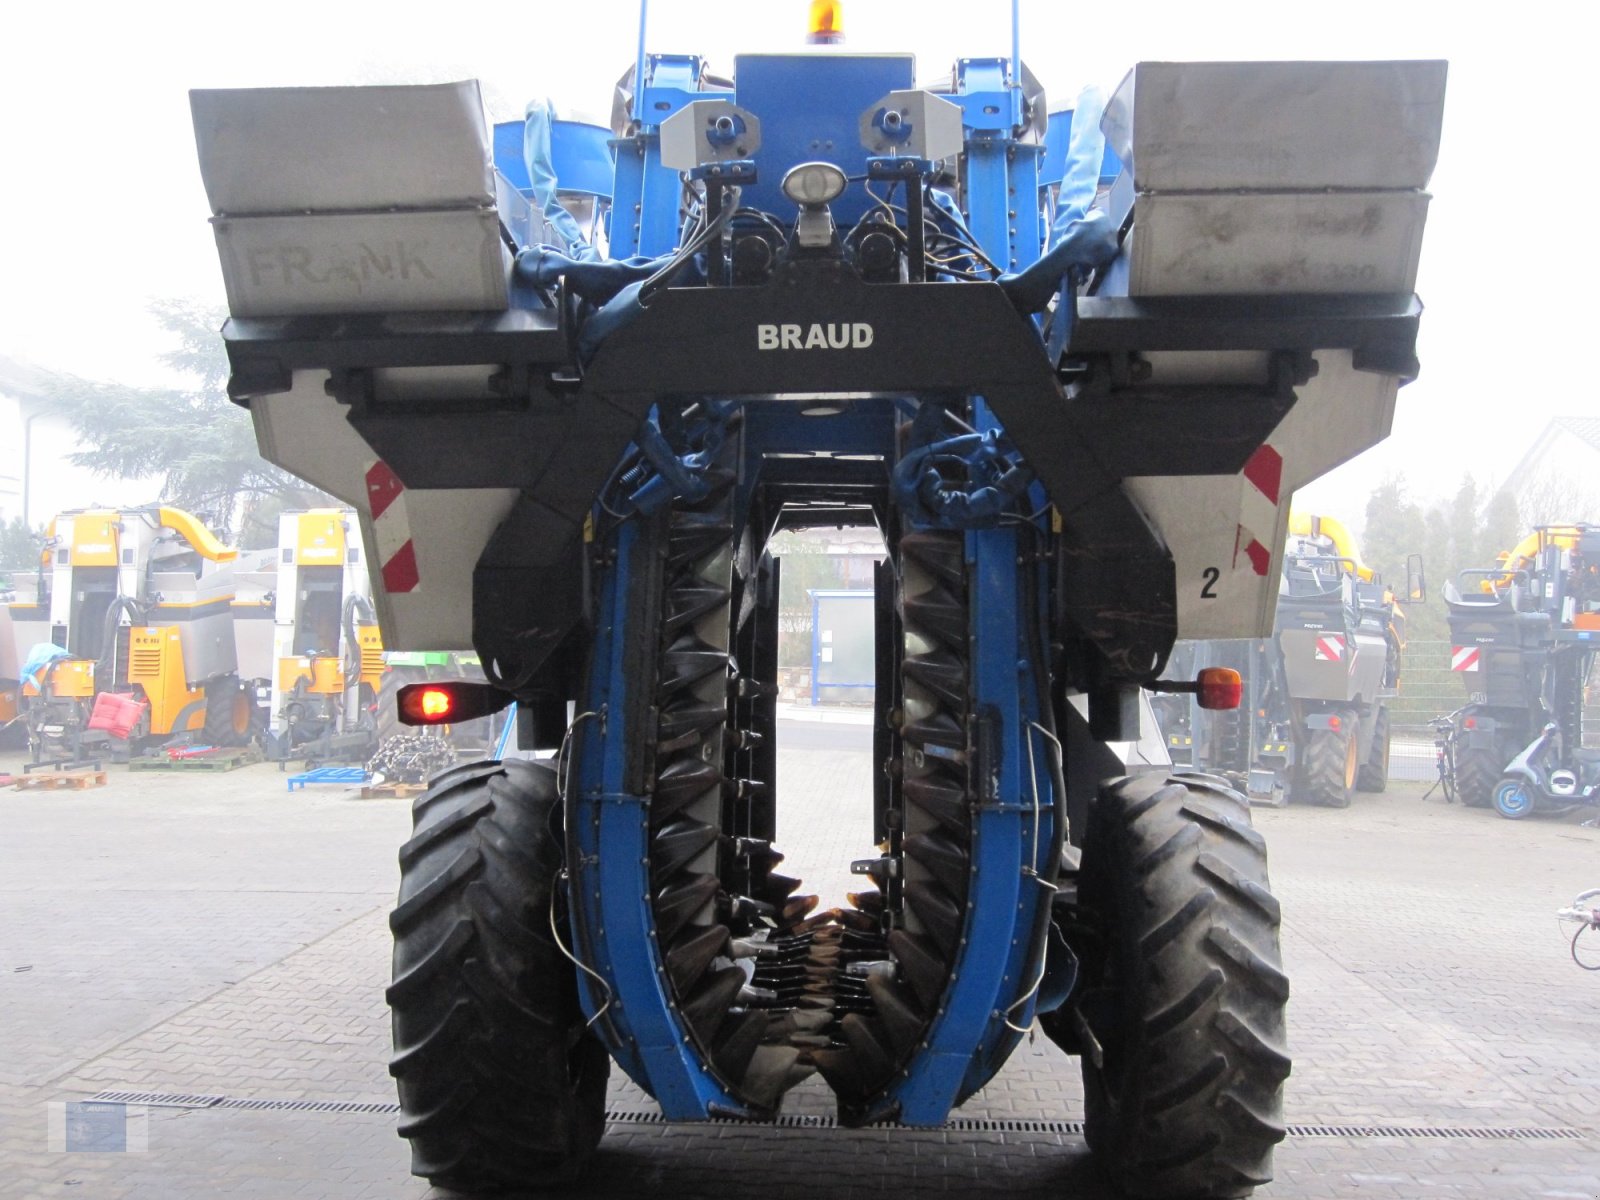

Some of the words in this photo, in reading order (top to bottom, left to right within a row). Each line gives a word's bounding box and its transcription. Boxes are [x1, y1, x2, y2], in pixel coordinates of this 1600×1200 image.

[246, 240, 436, 288] FRANK
[757, 322, 874, 351] BRAUD
[1200, 566, 1221, 599] 2
